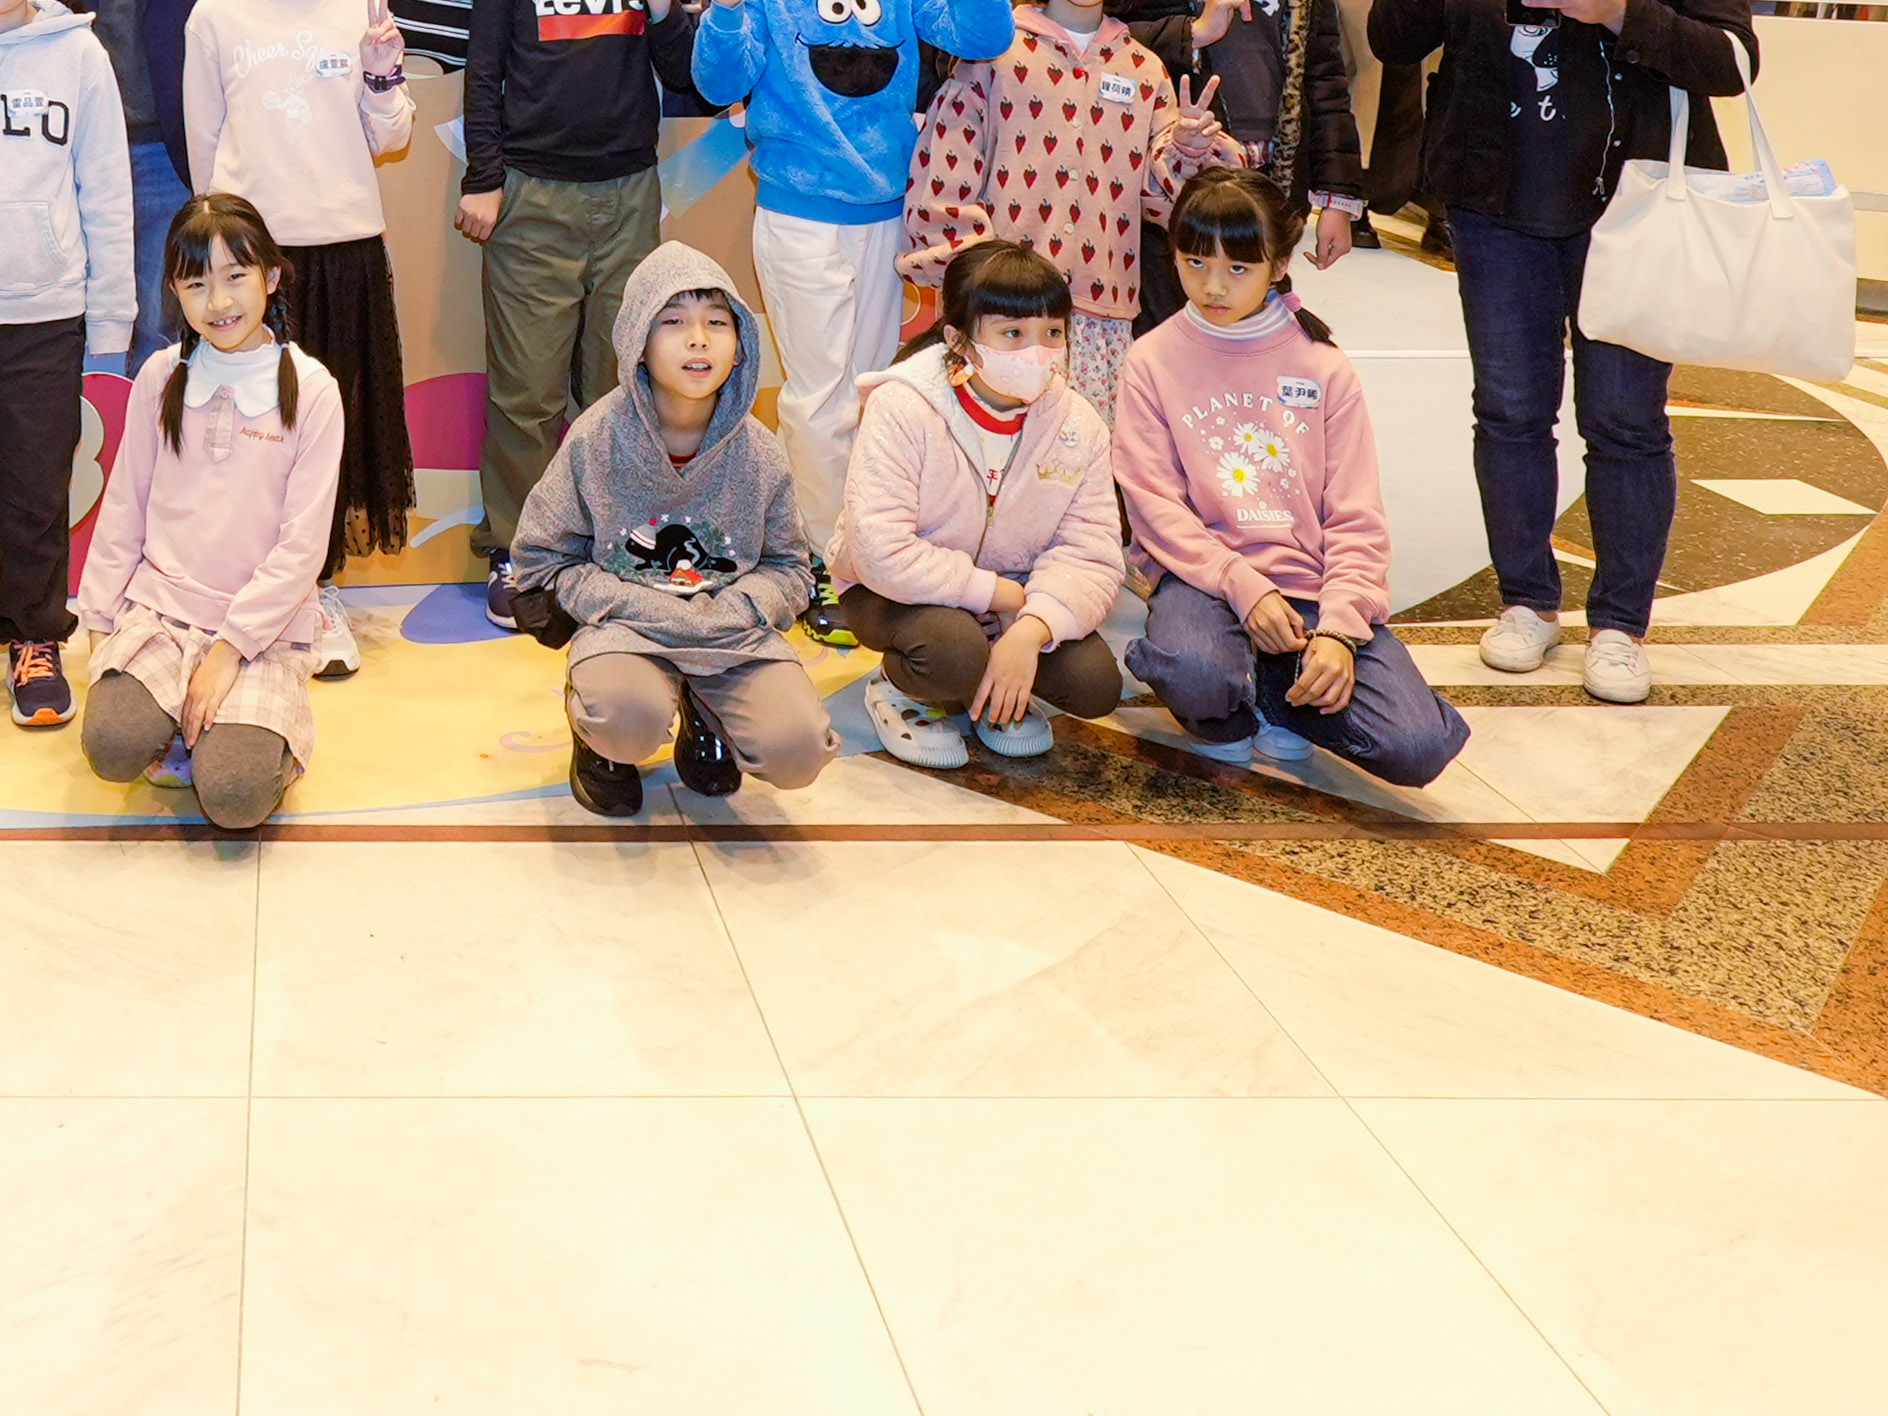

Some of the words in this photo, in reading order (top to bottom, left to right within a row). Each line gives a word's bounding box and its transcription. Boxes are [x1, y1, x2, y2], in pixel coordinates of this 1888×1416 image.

[1181, 392, 1274, 429] PLANET
[1281, 409, 1310, 434] OF
[1236, 508, 1294, 522] DAISIES
